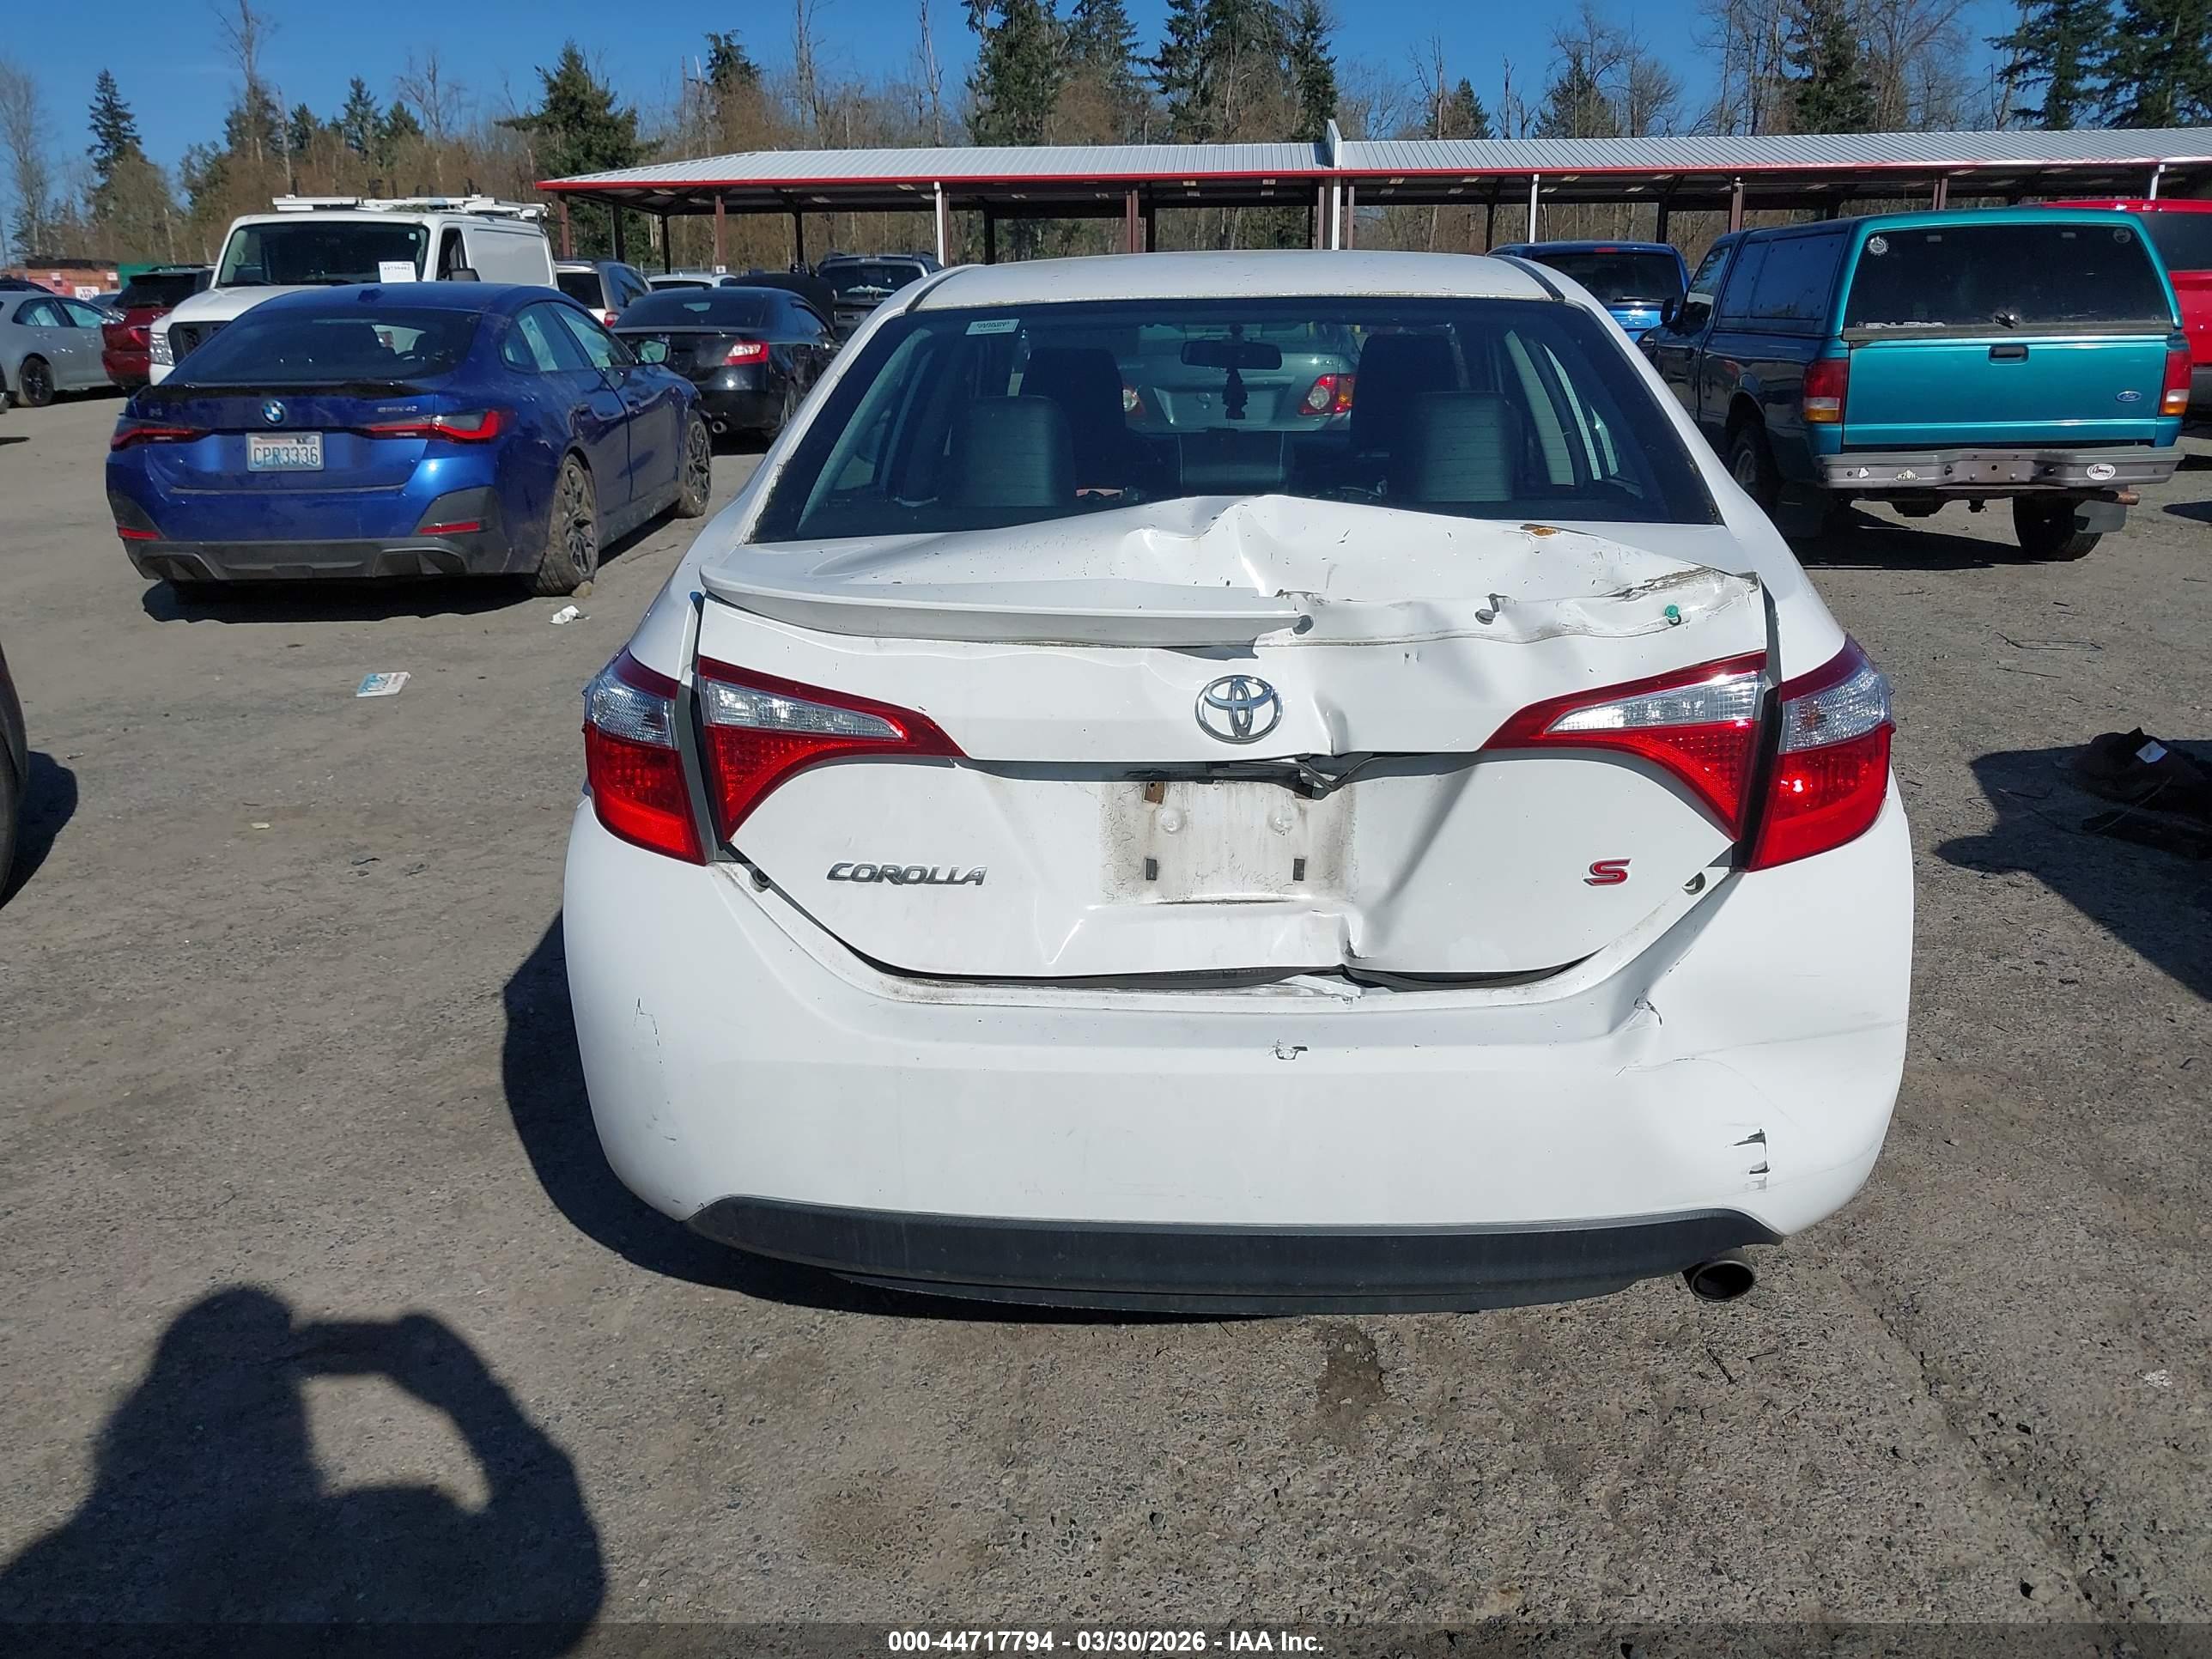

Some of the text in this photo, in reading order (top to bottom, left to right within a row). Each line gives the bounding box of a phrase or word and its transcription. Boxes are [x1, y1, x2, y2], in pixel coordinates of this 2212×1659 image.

[253, 447, 319, 465] CPR3336
[826, 862, 988, 885] COROLLA
[1583, 859, 1632, 886] S
